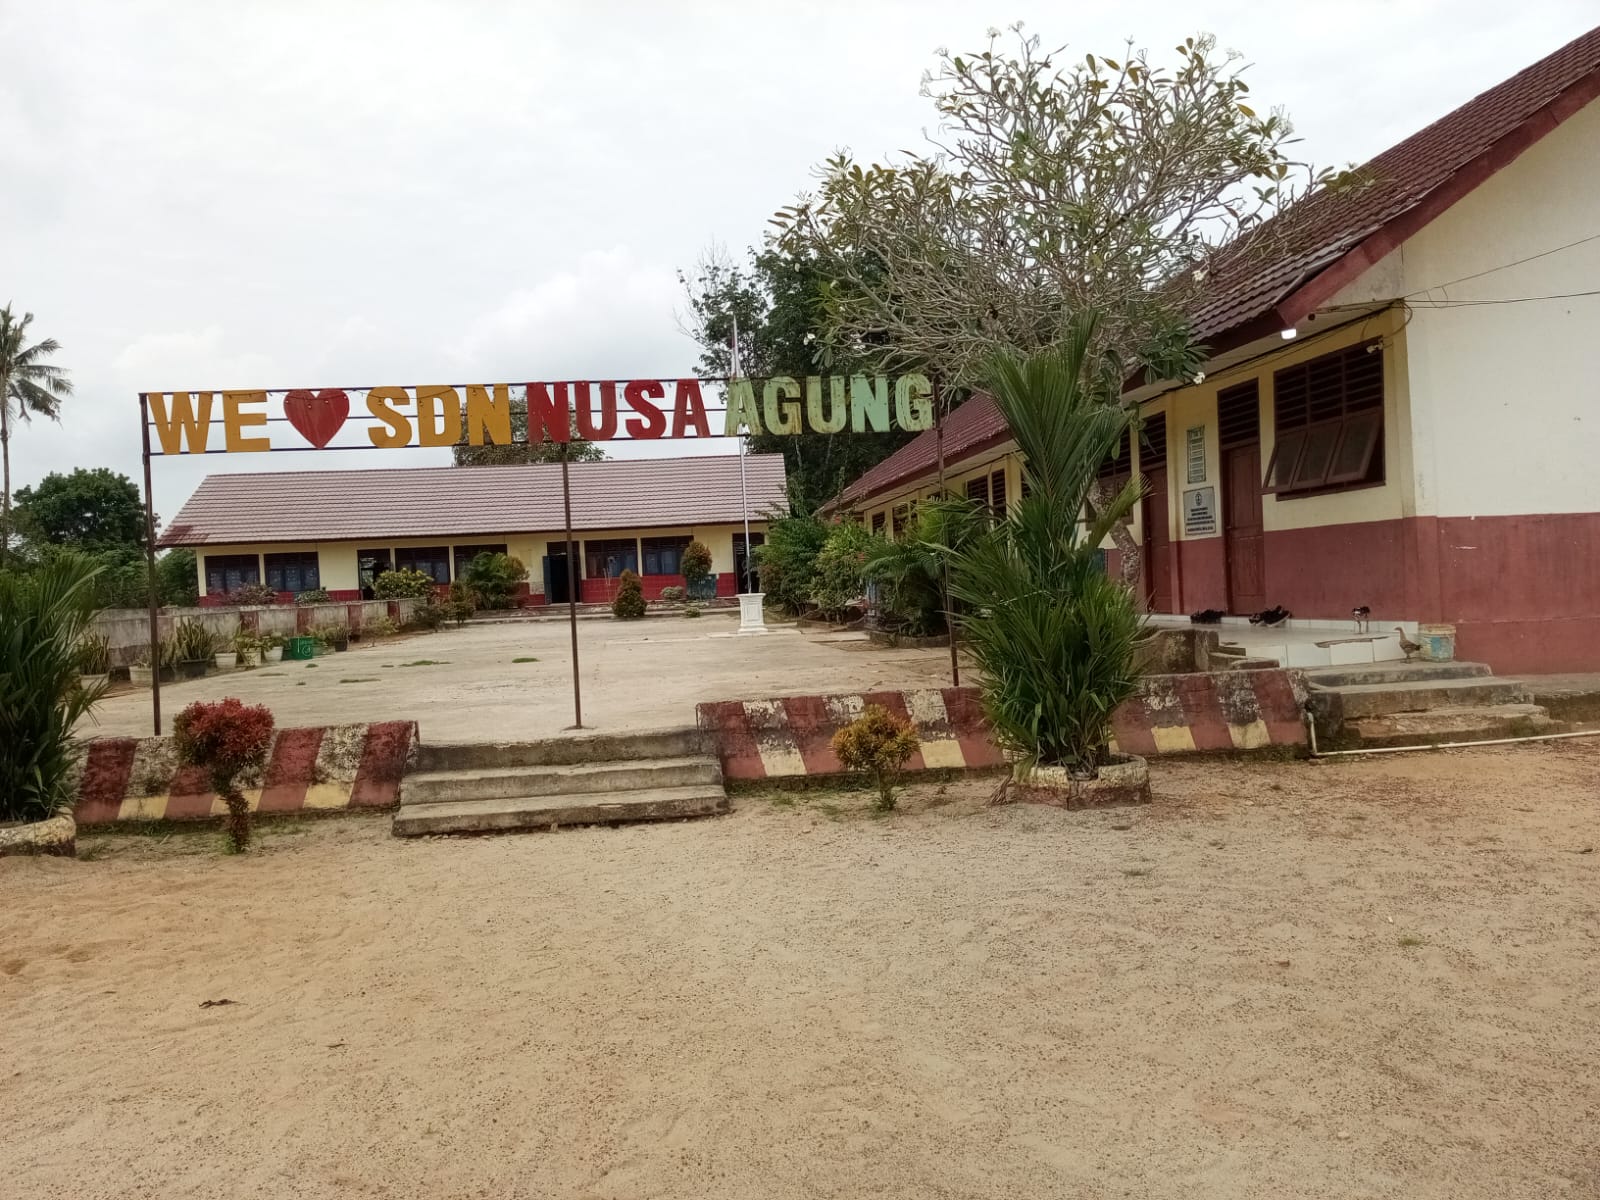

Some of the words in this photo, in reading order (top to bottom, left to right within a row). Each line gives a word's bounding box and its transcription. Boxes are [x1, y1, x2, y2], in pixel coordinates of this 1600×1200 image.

[148, 390, 271, 455] WE
[366, 384, 512, 448] SDN
[526, 379, 711, 444] NUSA
[723, 373, 934, 438] AGUNG
